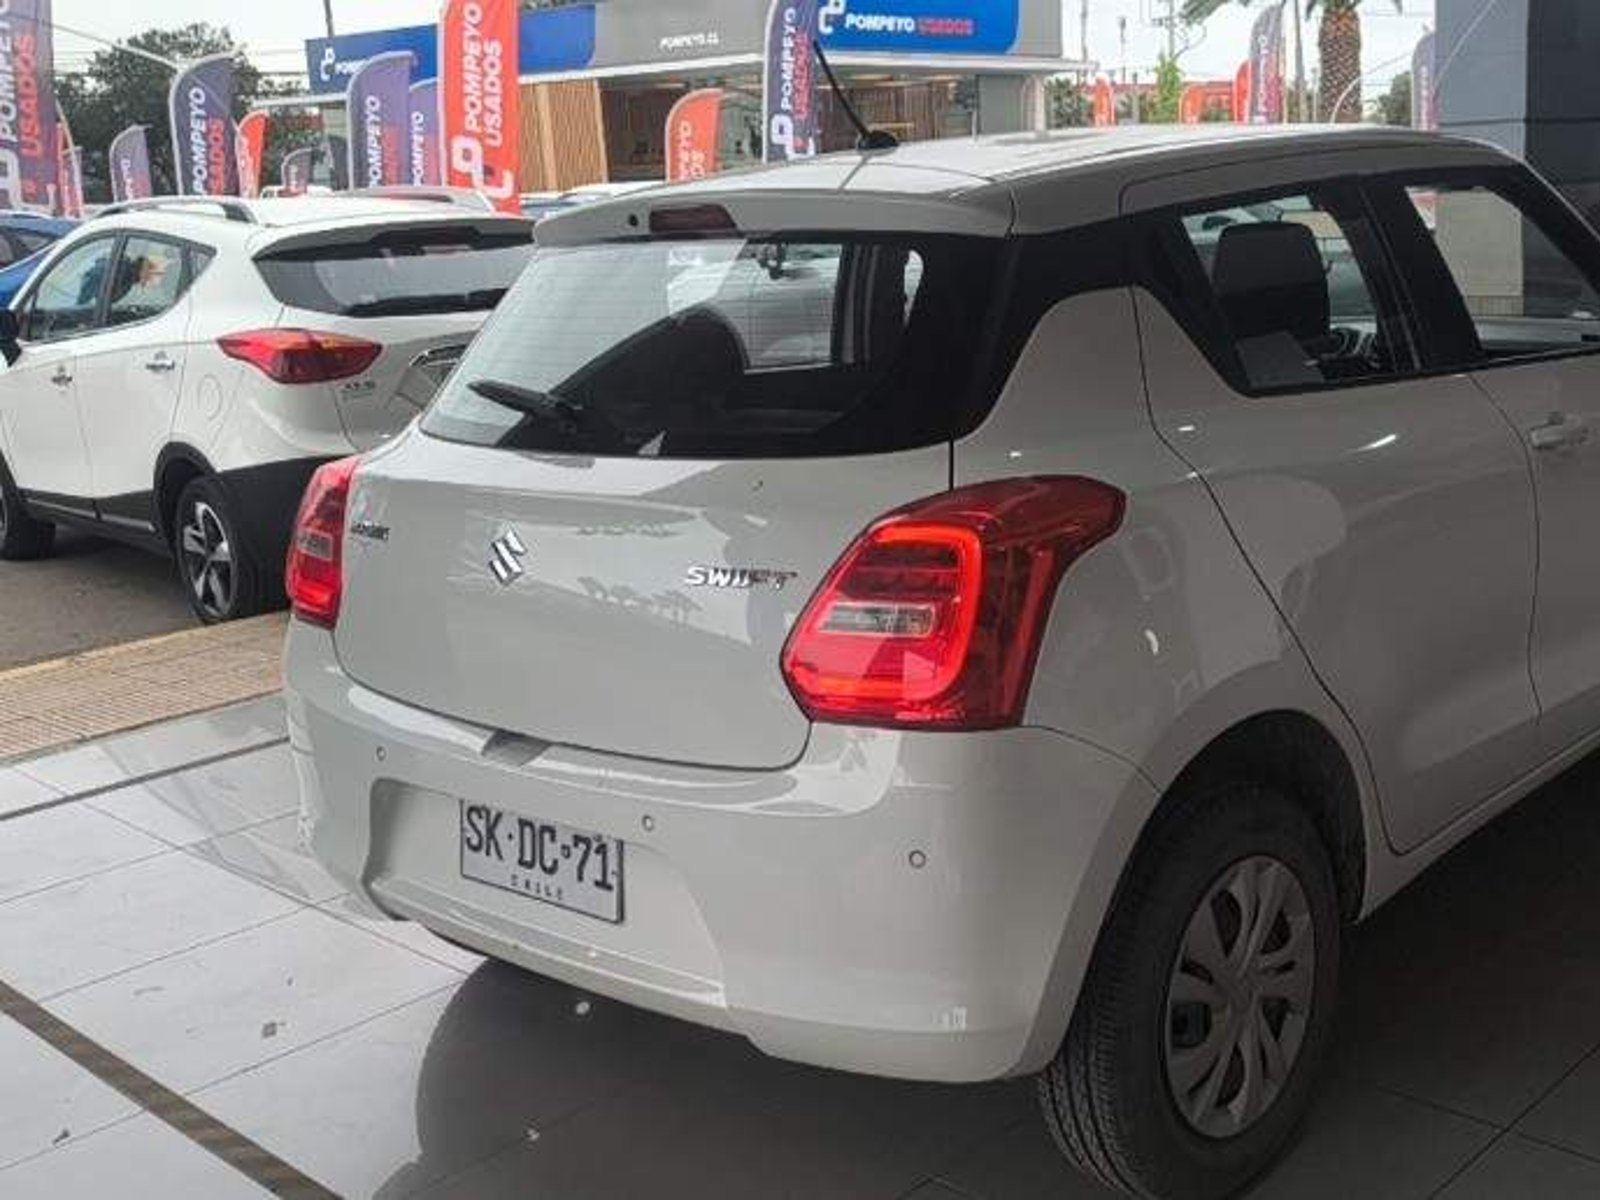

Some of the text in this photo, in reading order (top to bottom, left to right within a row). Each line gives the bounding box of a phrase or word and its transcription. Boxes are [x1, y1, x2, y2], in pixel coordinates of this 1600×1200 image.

[463, 1, 482, 133] POMPEYO
[782, 8, 797, 110] POMPEYO
[845, 12, 915, 33] POMPEYO
[483, 38, 503, 148] USADOS
